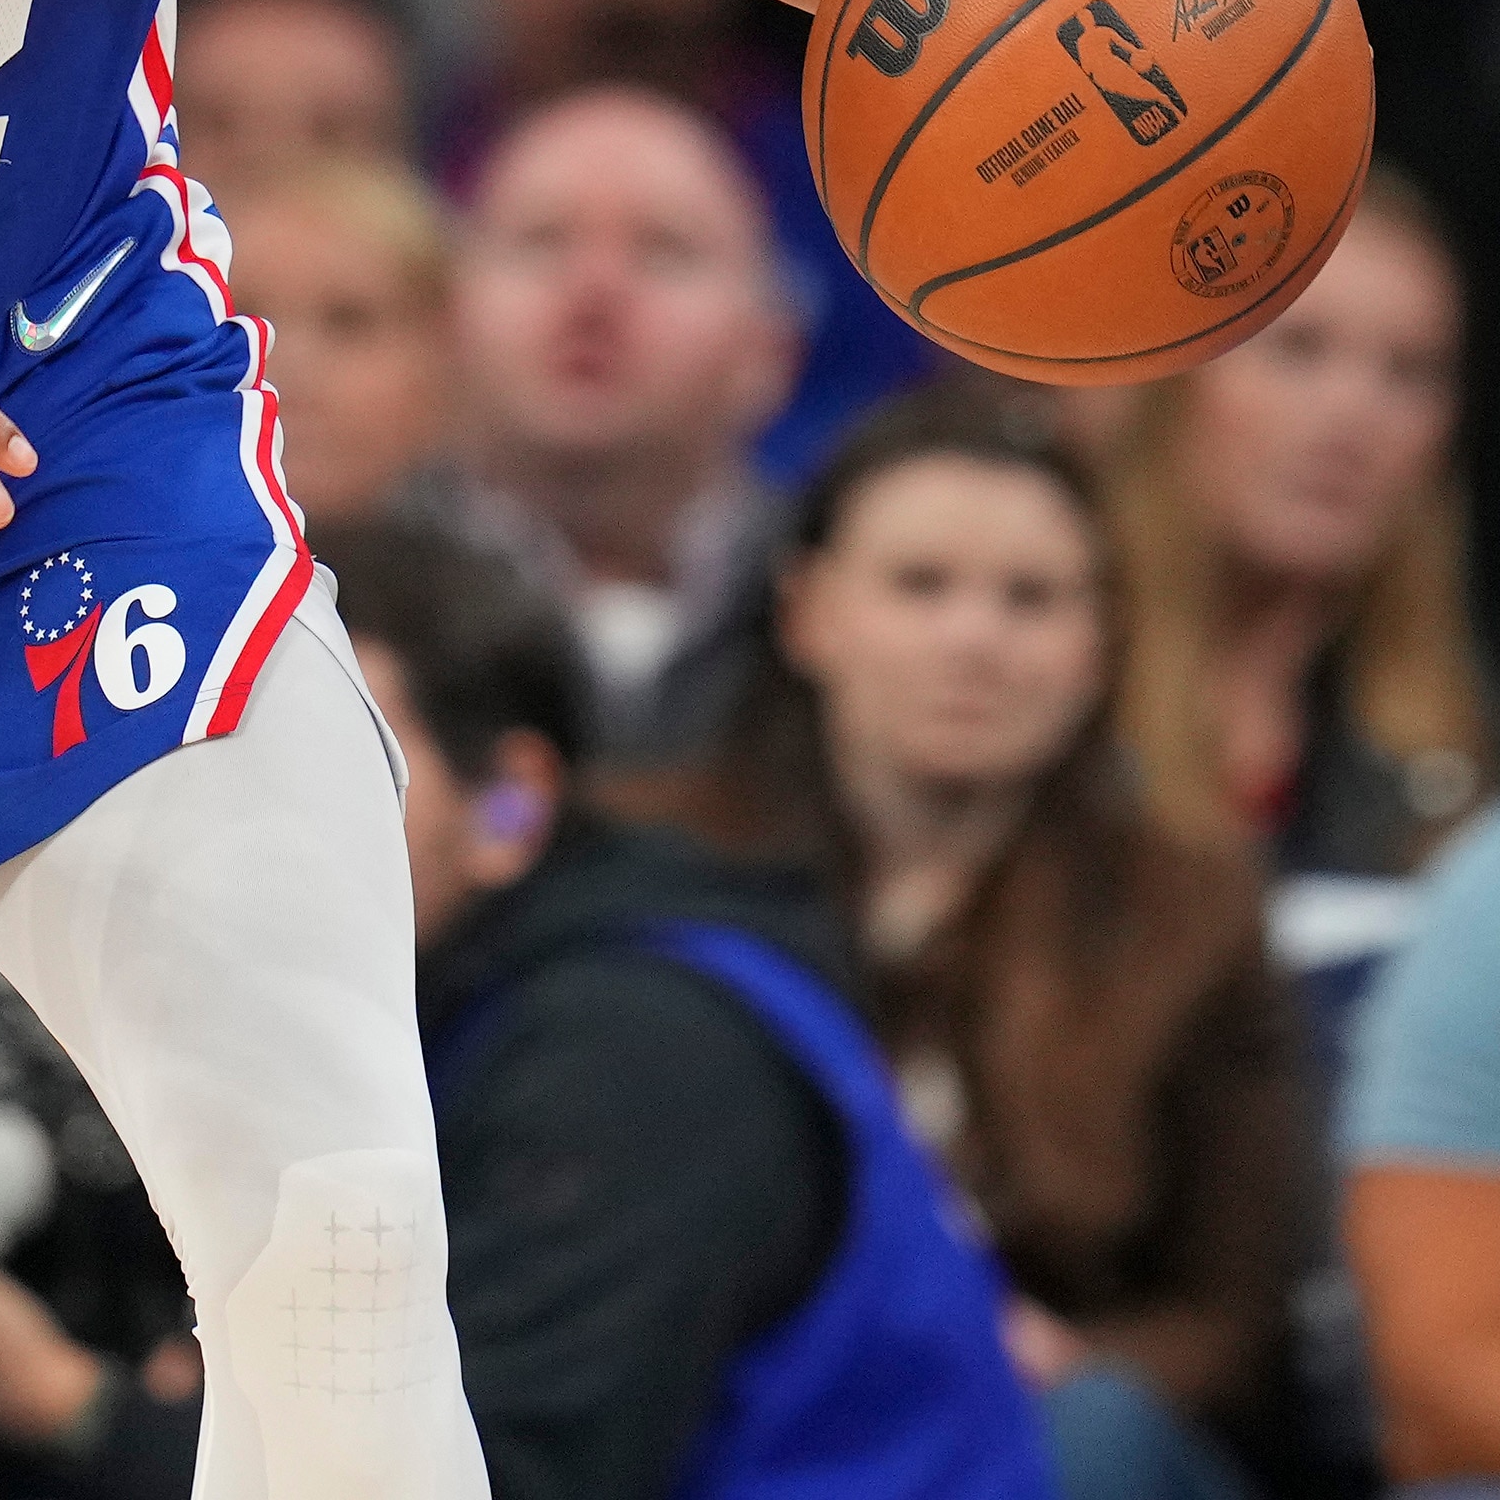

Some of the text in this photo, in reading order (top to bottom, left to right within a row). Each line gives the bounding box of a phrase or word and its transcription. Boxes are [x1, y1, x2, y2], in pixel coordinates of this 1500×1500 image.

[975, 92, 1087, 185] OFFICIAL GAME BALL
[1131, 105, 1170, 141] NBA
[24, 583, 187, 758] 76
